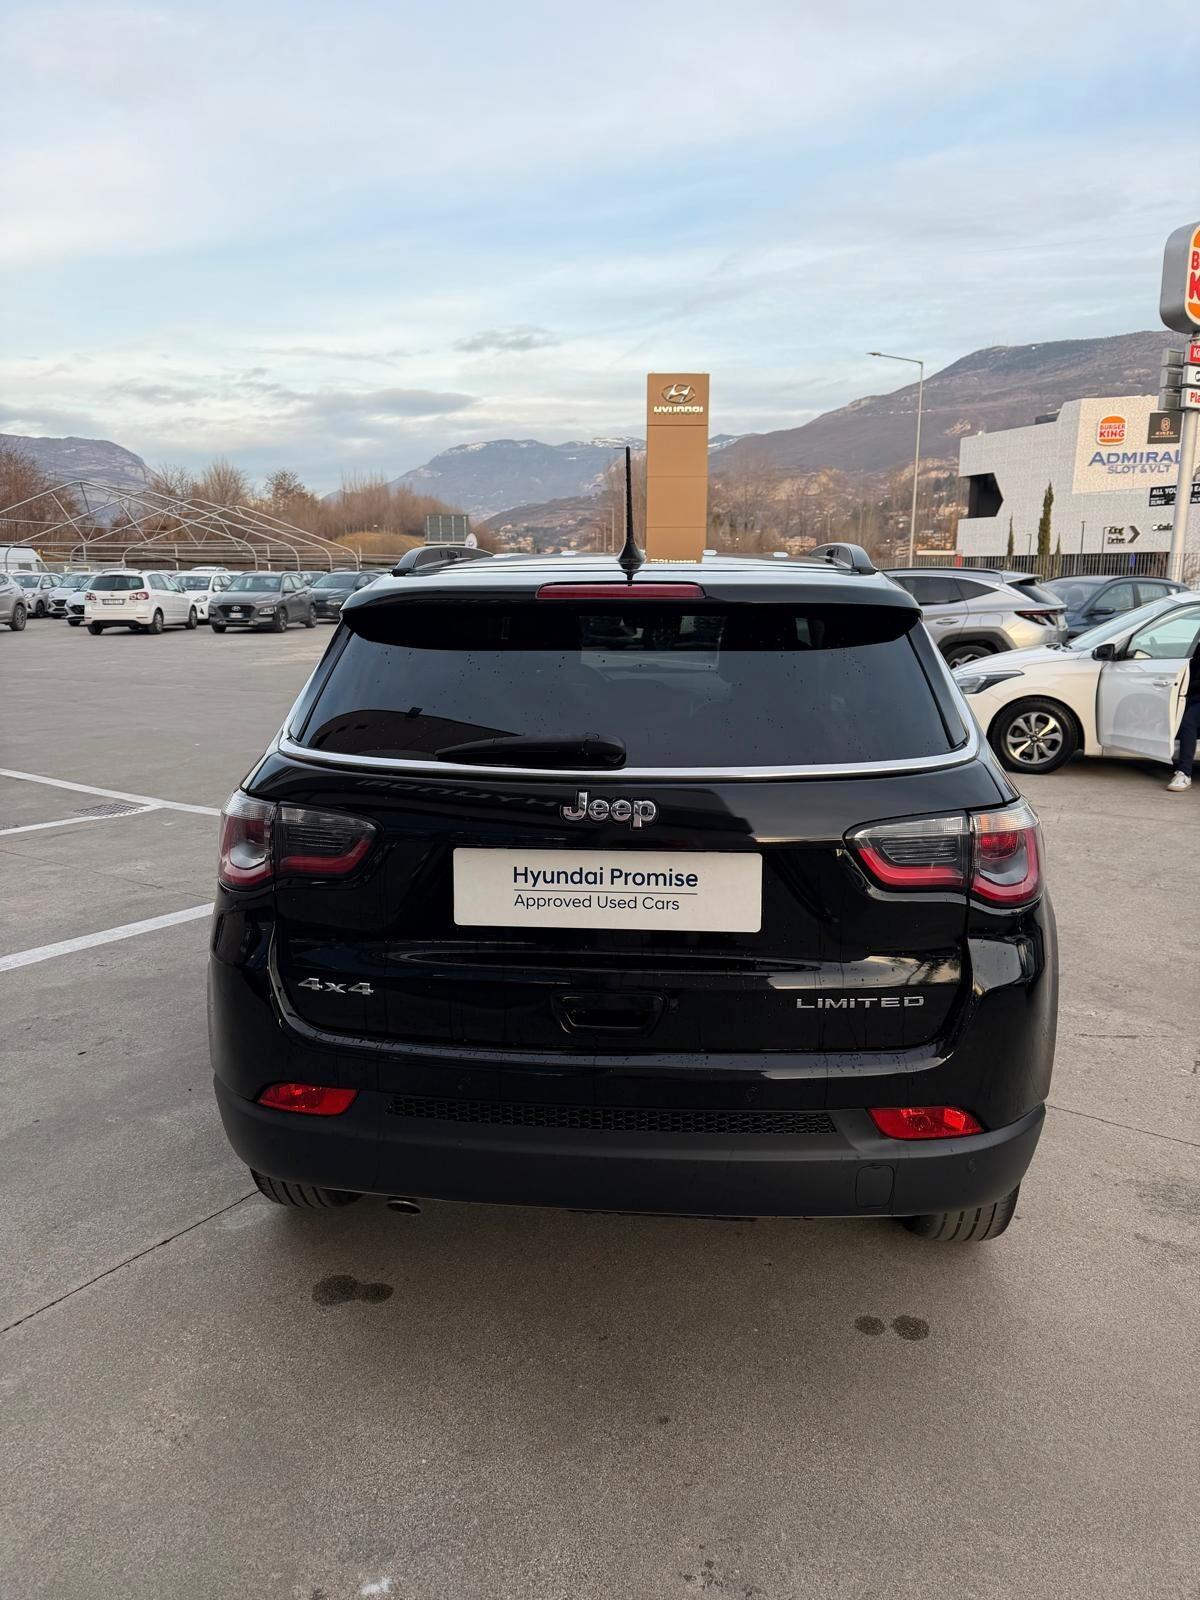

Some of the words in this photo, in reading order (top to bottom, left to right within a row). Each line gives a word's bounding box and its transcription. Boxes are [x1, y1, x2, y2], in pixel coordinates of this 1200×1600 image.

[1098, 430, 1125, 438] KING
[1088, 449, 1180, 467] ADMIRAL
[1107, 464, 1138, 475] SLOT
[1139, 464, 1148, 474] &
[1149, 464, 1172, 474] VLT
[562, 791, 656, 828] Jeep
[513, 866, 604, 887] Hyundai
[610, 868, 698, 887] Promise
[514, 894, 592, 910] Approved
[597, 895, 637, 909] Used
[642, 896, 680, 910] Cars
[298, 977, 374, 995] 4x4
[796, 996, 925, 1009] LIMITED
